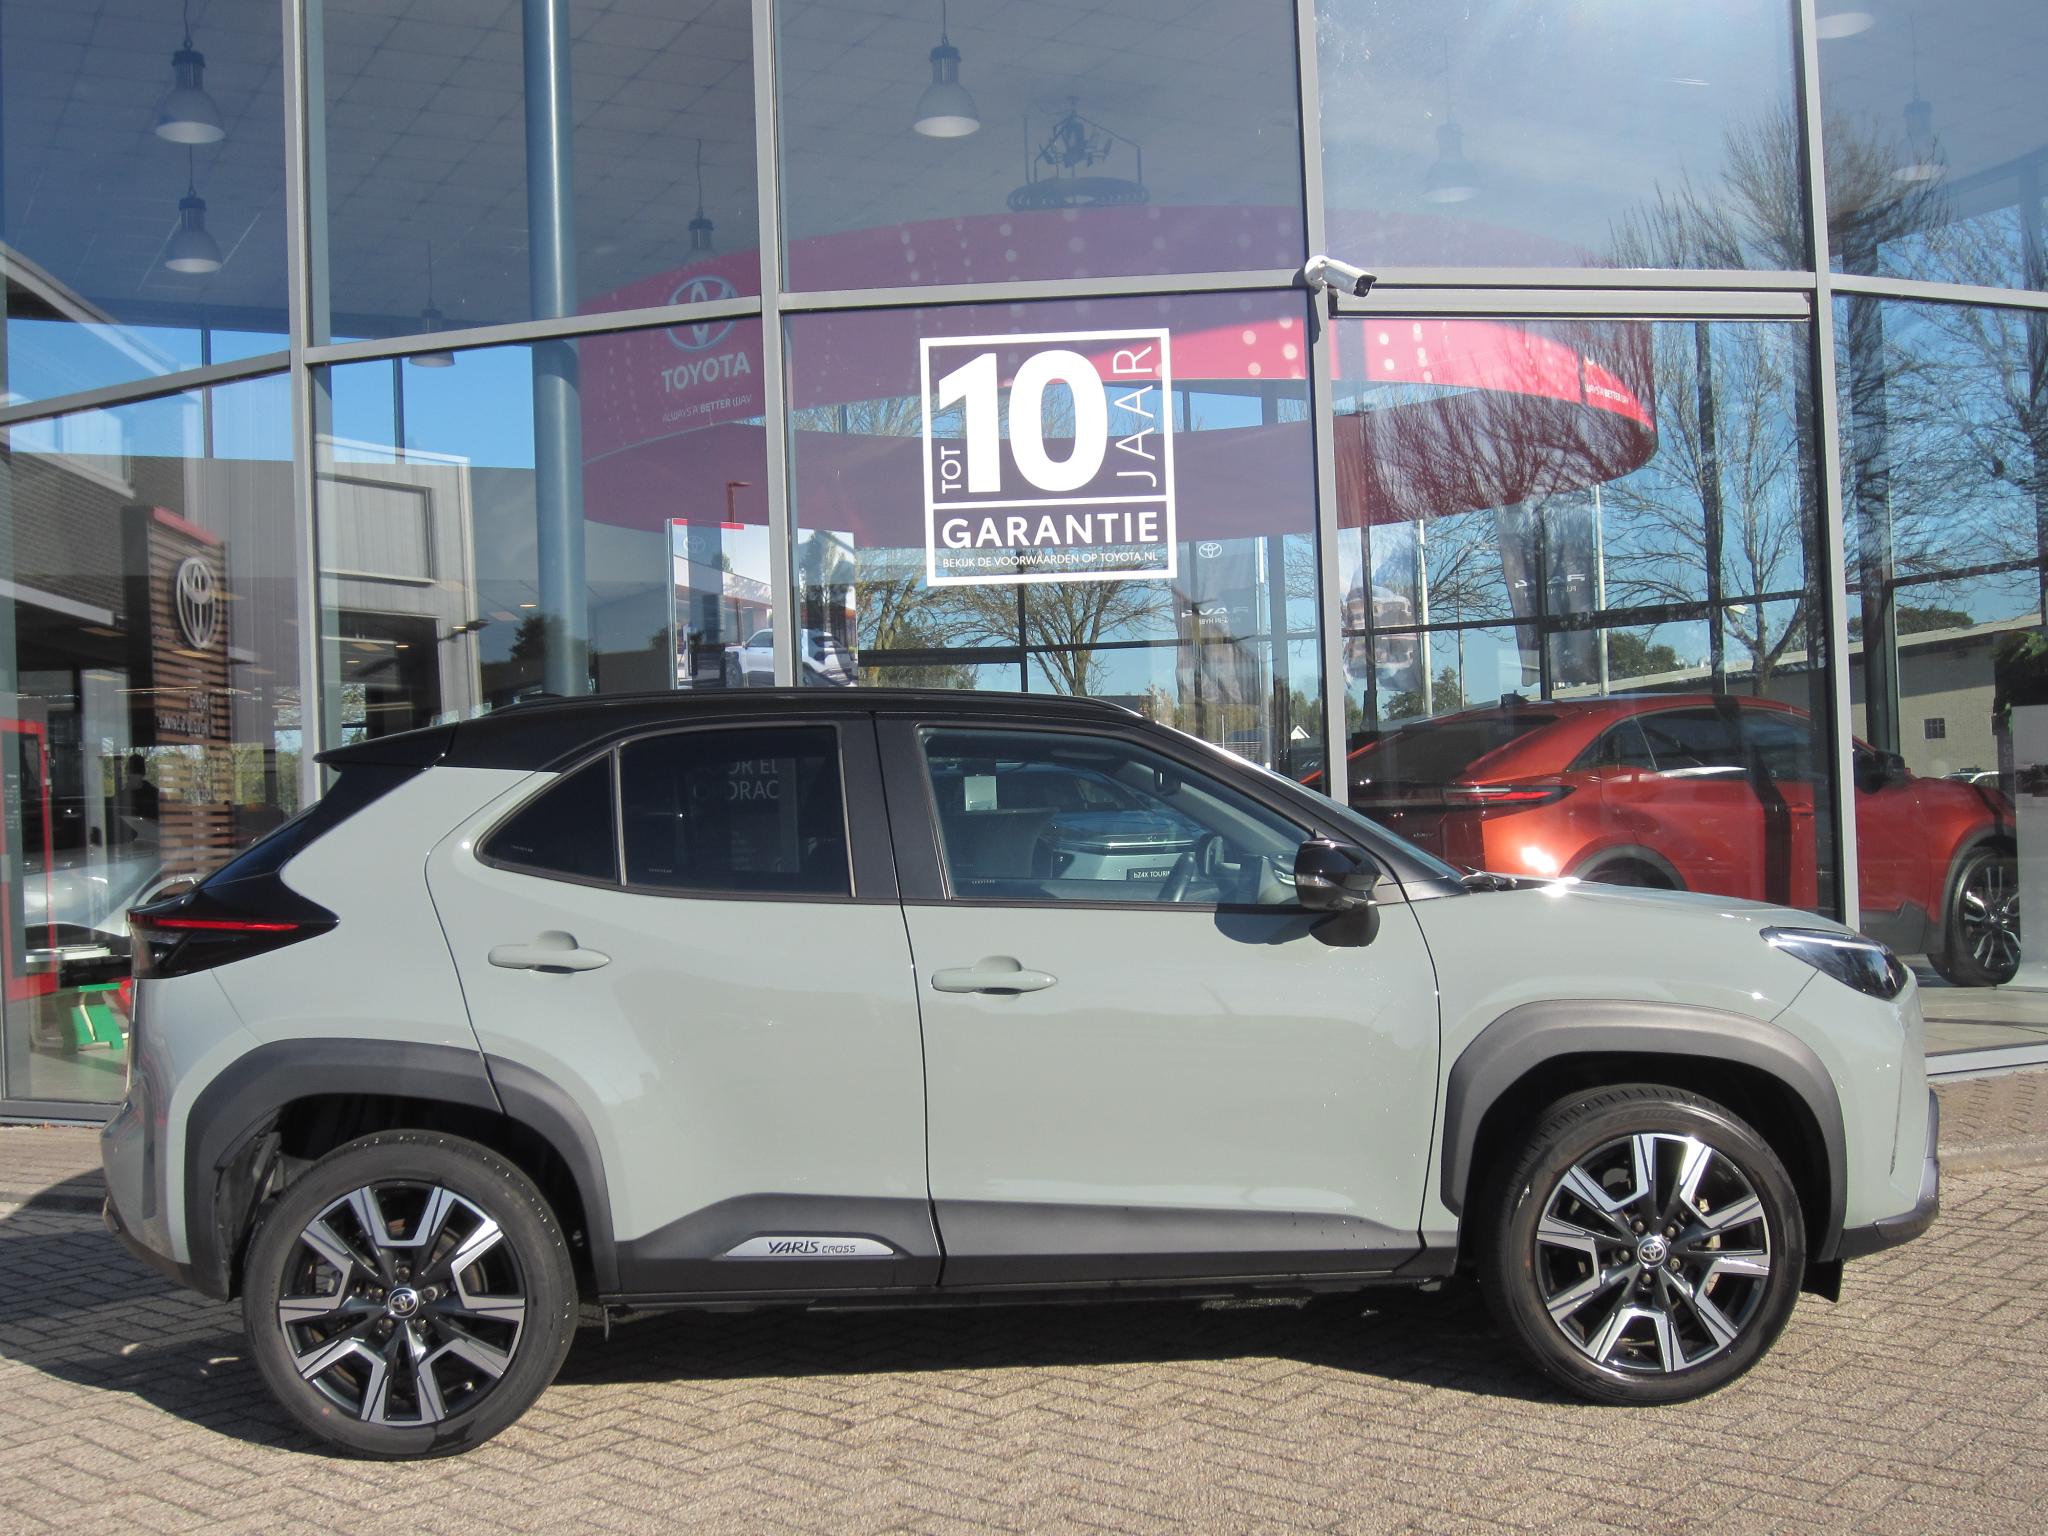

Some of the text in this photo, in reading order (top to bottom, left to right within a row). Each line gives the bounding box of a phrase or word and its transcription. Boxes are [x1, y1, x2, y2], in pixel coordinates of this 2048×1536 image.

[661, 351, 751, 393] TOYOTA
[700, 399, 732, 413] BETTER
[939, 350, 1108, 492] 10
[1113, 345, 1156, 488] JAAR
[941, 446, 961, 494] TOT
[942, 512, 1159, 549] GARANTIE
[943, 551, 1158, 568] BEKIJK DE VOORWAARDEN OP TOYOTA.NL
[768, 1240, 856, 1254] YARIS CROSS
